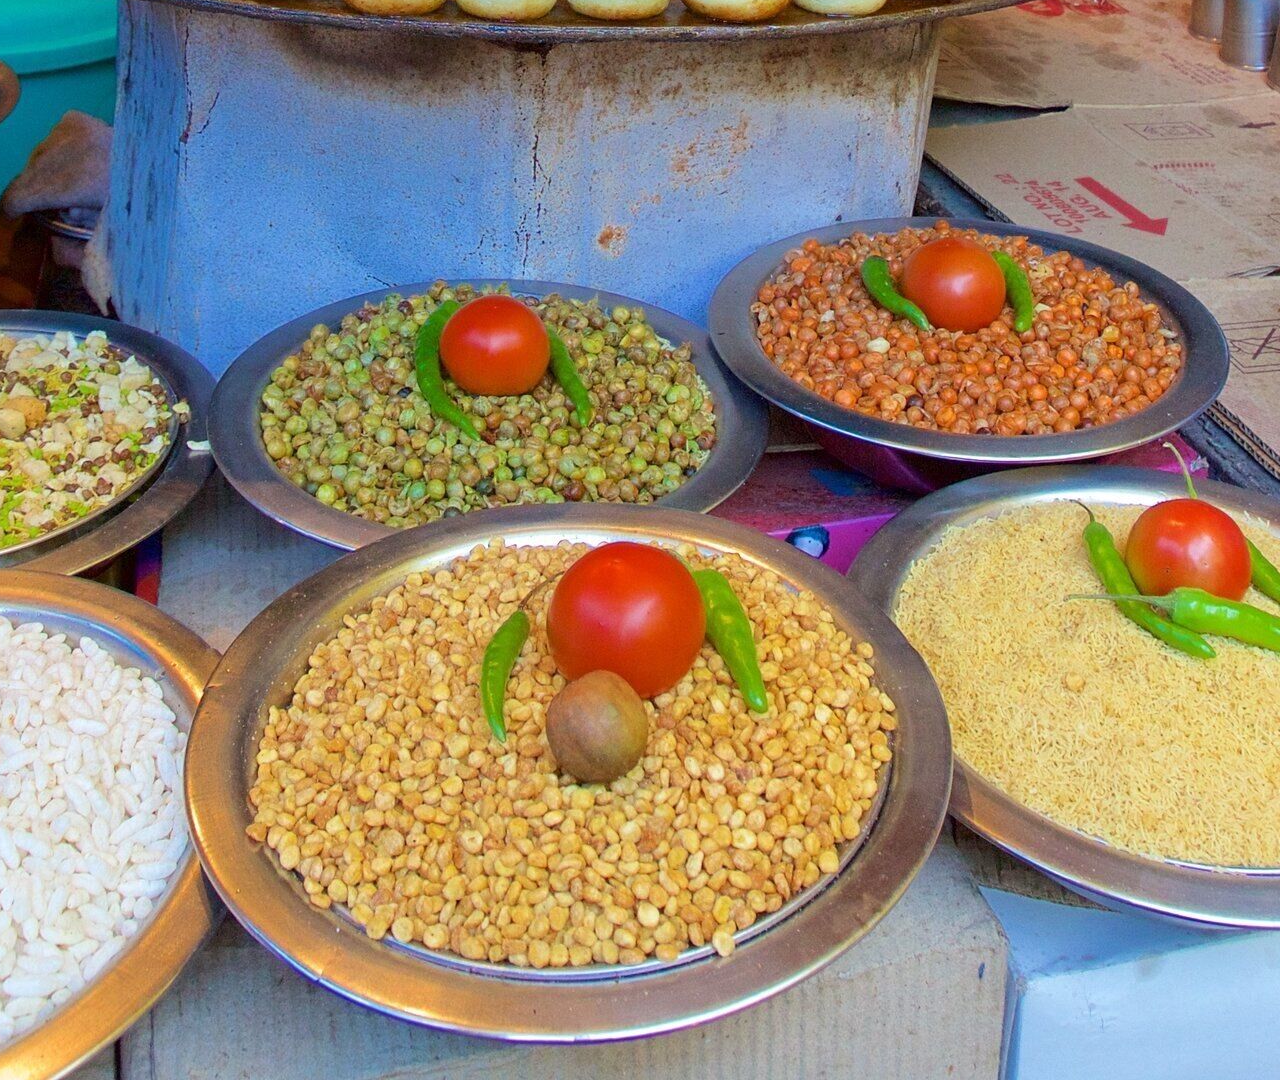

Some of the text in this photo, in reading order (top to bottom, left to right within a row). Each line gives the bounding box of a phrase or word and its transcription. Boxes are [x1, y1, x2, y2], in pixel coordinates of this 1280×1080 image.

[1046, 181, 1113, 219] AUG. 14
[1044, 211, 1083, 235] LOT
